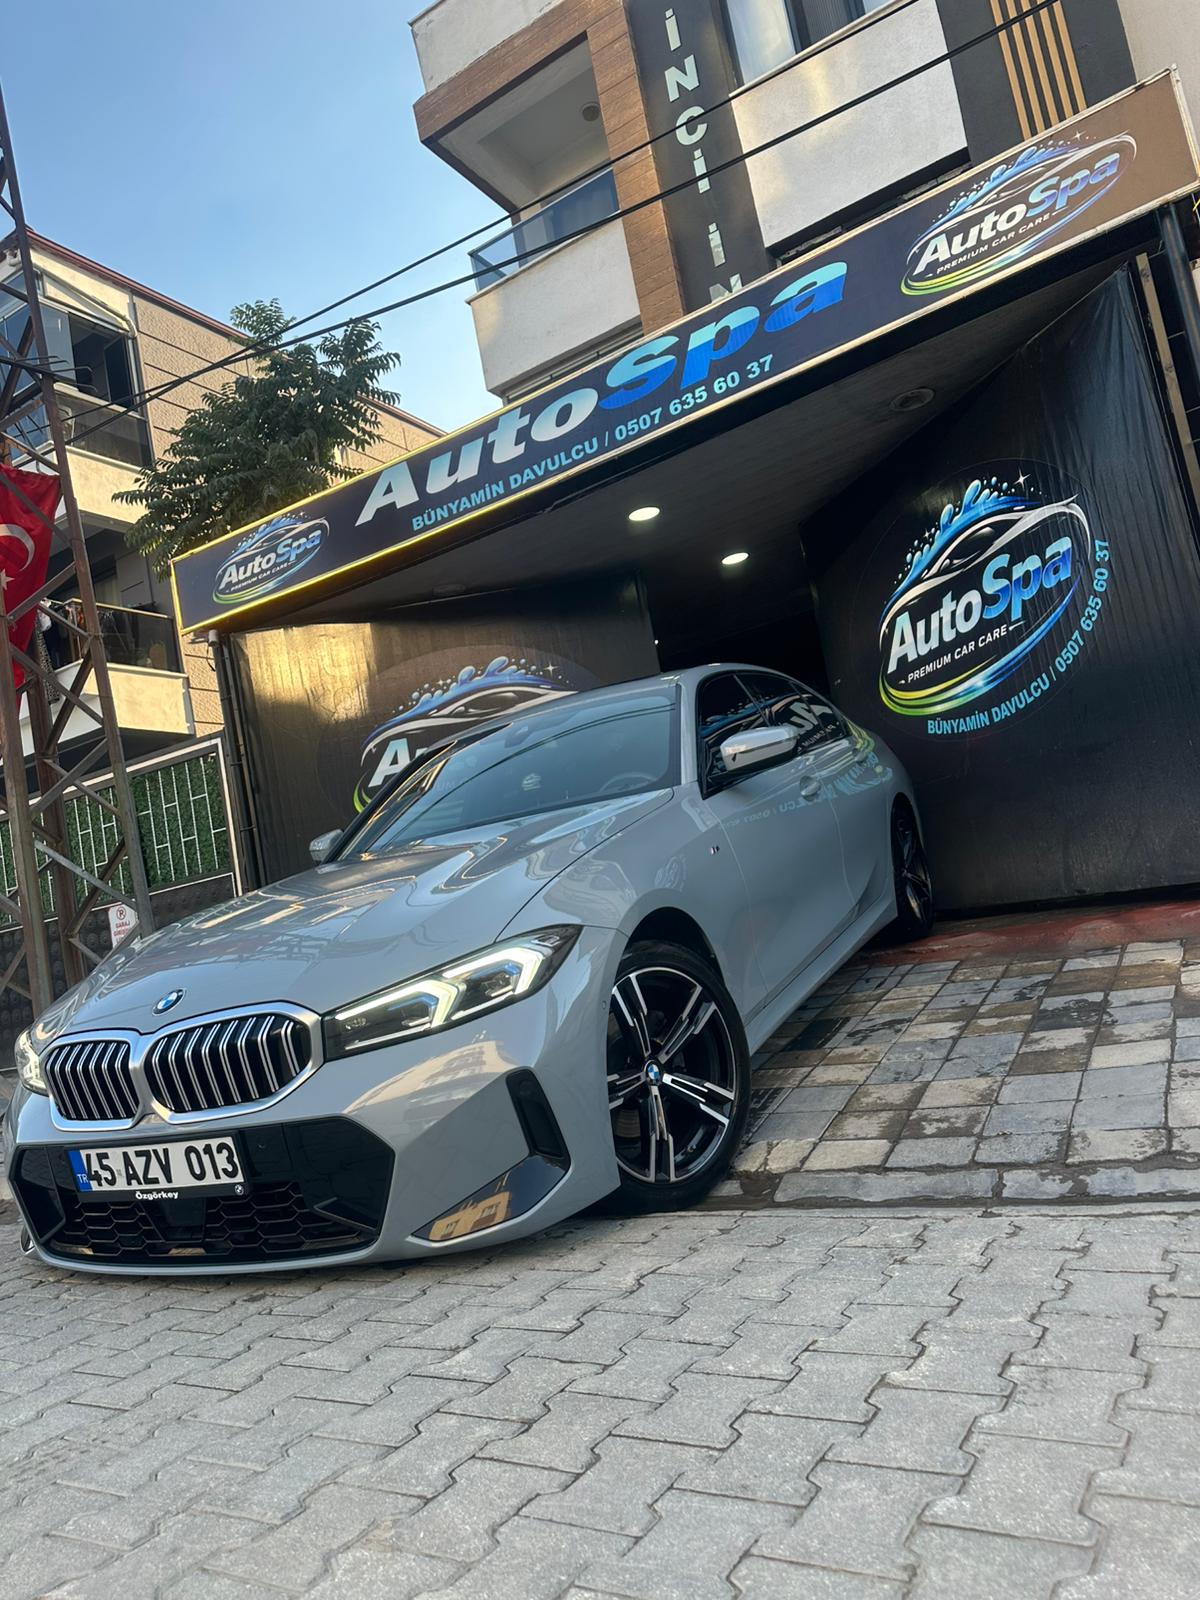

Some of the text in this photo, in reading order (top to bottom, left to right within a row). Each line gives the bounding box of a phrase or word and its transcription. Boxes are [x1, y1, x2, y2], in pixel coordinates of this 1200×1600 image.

[913, 152, 1120, 276] AutoSpa
[936, 213, 1051, 274] PREMIUM CAR CARE
[412, 479, 505, 531] BÜNYAMİN
[509, 436, 599, 489] DAVULCU
[615, 407, 663, 441] 0507
[669, 386, 708, 416] 635
[713, 371, 741, 395] 60
[746, 354, 773, 379] 37
[219, 530, 322, 591] AutoSpa
[258, 571, 270, 580] CAR
[271, 563, 288, 574] CARE
[1095, 539, 1110, 562] 37
[1094, 567, 1109, 593] 60
[887, 536, 1073, 674] AutoSpa
[1080, 595, 1103, 632] 635
[907, 624, 1009, 684] PREMIUM CAR CARE
[1055, 631, 1085, 673] 0507
[992, 676, 1051, 723] DAVULCU
[927, 710, 991, 735] BÜNYAMİN
[77, 1142, 239, 1187] TR 45 AZV 013
[135, 1190, 179, 1200] Özgörkey
